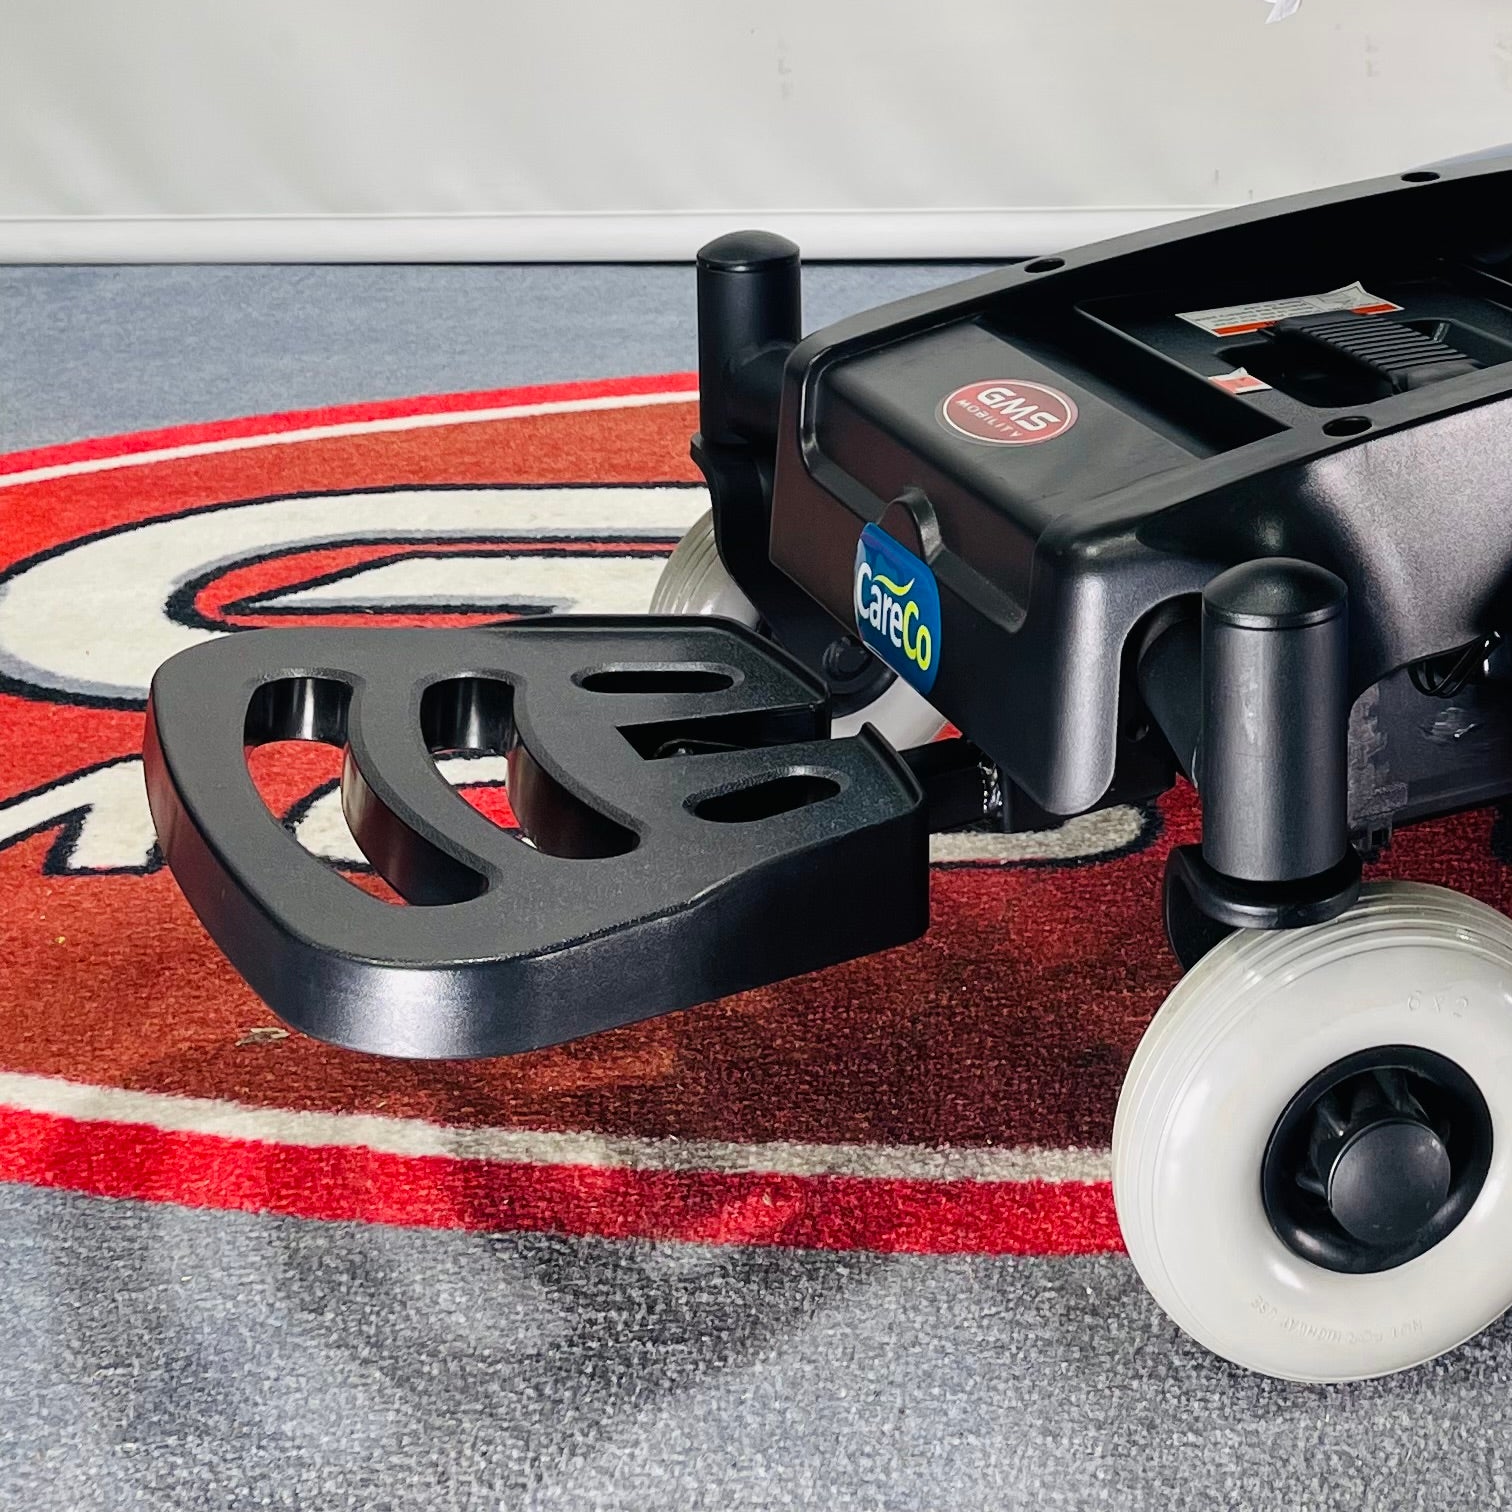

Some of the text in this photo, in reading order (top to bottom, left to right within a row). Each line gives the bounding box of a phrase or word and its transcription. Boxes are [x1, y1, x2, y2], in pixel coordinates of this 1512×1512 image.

[956, 399, 1023, 437] MOBILITY
[977, 387, 1061, 431] GMS
[857, 562, 931, 671] CareCo
